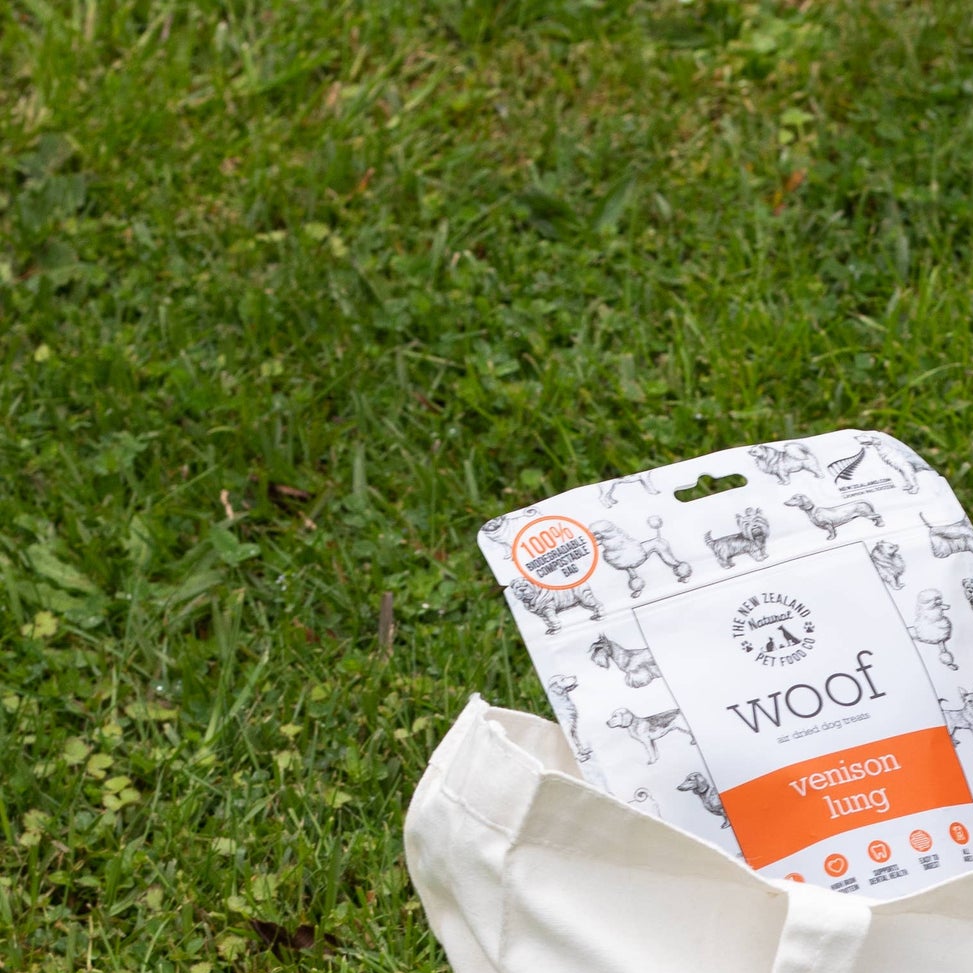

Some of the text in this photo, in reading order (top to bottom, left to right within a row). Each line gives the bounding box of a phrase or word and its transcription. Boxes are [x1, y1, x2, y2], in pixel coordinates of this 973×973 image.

[521, 523, 574, 558] 100%
[525, 536, 587, 572] BIODEGRADABLE
[536, 546, 591, 578] COMPOSTABLE
[561, 563, 579, 577] BAG
[732, 593, 811, 638] THE NEW ZEALAND
[748, 610, 794, 631] Natural
[755, 637, 816, 667] PET FOOD CO
[726, 650, 887, 733] woof
[792, 725, 821, 739] dried
[821, 719, 843, 730] dog
[842, 712, 871, 725] treats
[789, 753, 901, 797] venison
[822, 787, 890, 819] lung
